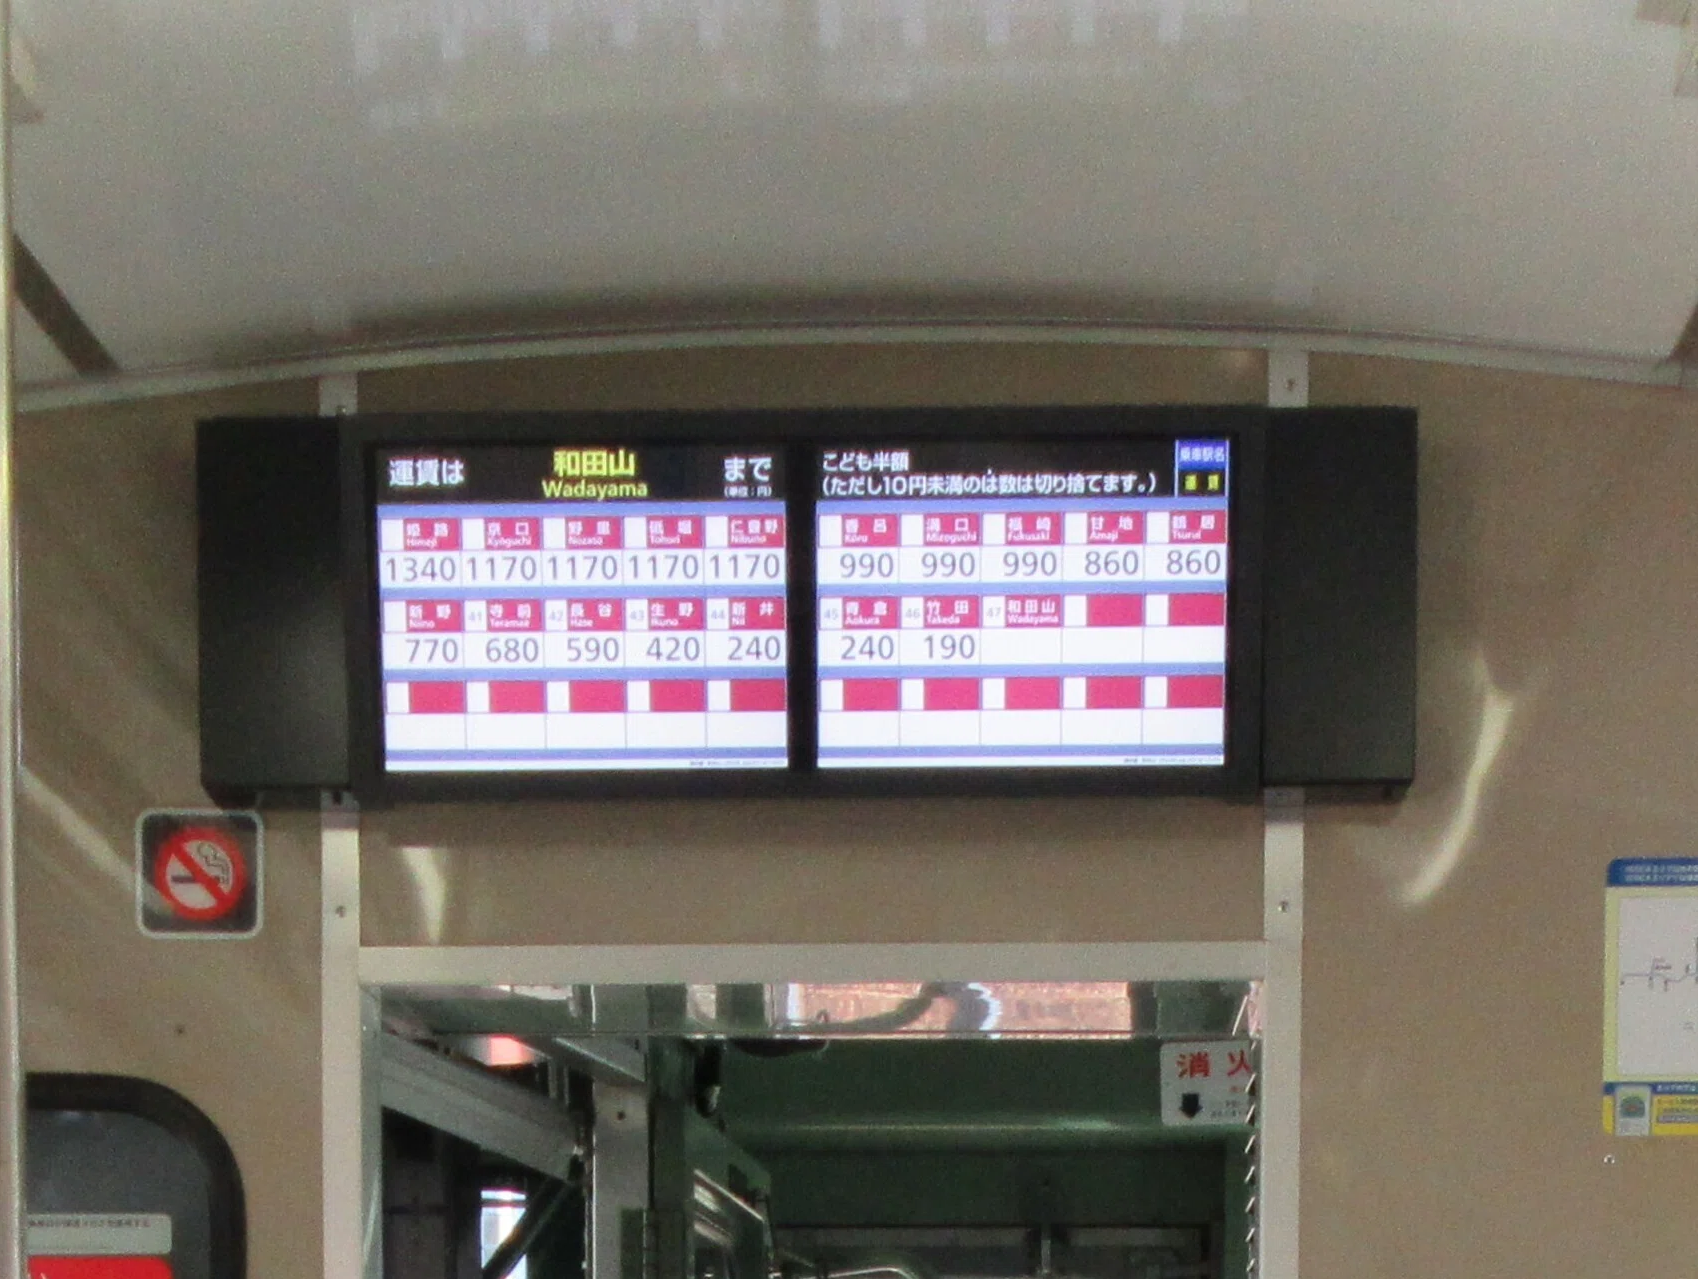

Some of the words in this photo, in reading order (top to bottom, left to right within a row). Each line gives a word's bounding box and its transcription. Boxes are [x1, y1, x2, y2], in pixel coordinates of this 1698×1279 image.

[389, 459, 465, 486] 運賃は
[554, 449, 636, 476] 和田山
[724, 456, 772, 482] まで
[823, 451, 909, 472] こども半額
[541, 480, 649, 501] Wadayama
[488, 521, 529, 536] 京口
[569, 520, 610, 536] 野里
[1091, 515, 1133, 531] 甘地
[406, 537, 438, 548] Himeji
[926, 531, 976, 544] Mizoguchi
[1007, 531, 1049, 541] Fukusaki
[1089, 530, 1118, 542] Amaji
[386, 556, 456, 582] 1340
[467, 555, 537, 581] 1170
[548, 555, 618, 580] 1170
[629, 554, 699, 580] 1170
[710, 553, 780, 579] 1170
[840, 552, 894, 578] 990
[921, 552, 975, 578] 990
[1003, 551, 1057, 577] 990
[1085, 550, 1139, 576] 860
[1166, 549, 1221, 575] 860
[408, 603, 451, 620] 新野
[490, 603, 531, 619] 寺前
[571, 602, 612, 618] 長谷
[651, 602, 694, 617] 生野
[732, 601, 774, 617] 新井
[823, 608, 838, 620] 45
[905, 608, 920, 620] 46
[927, 600, 969, 616] 竹田
[986, 607, 1001, 619] 47
[1008, 599, 1055, 614] 和田山
[490, 618, 530, 628] Teramae
[570, 618, 593, 627] Hase
[710, 609, 725, 621] 44
[845, 615, 880, 625] Aokura
[926, 615, 960, 624] Takeda
[1007, 613, 1059, 624] Wadayama
[405, 638, 459, 663] 770
[485, 637, 539, 663] 680
[567, 637, 619, 662] 590
[646, 636, 701, 661] 420
[727, 635, 781, 661] 240
[841, 635, 894, 660] 240
[925, 634, 975, 659] 190
[1176, 1048, 1253, 1079] 消火
